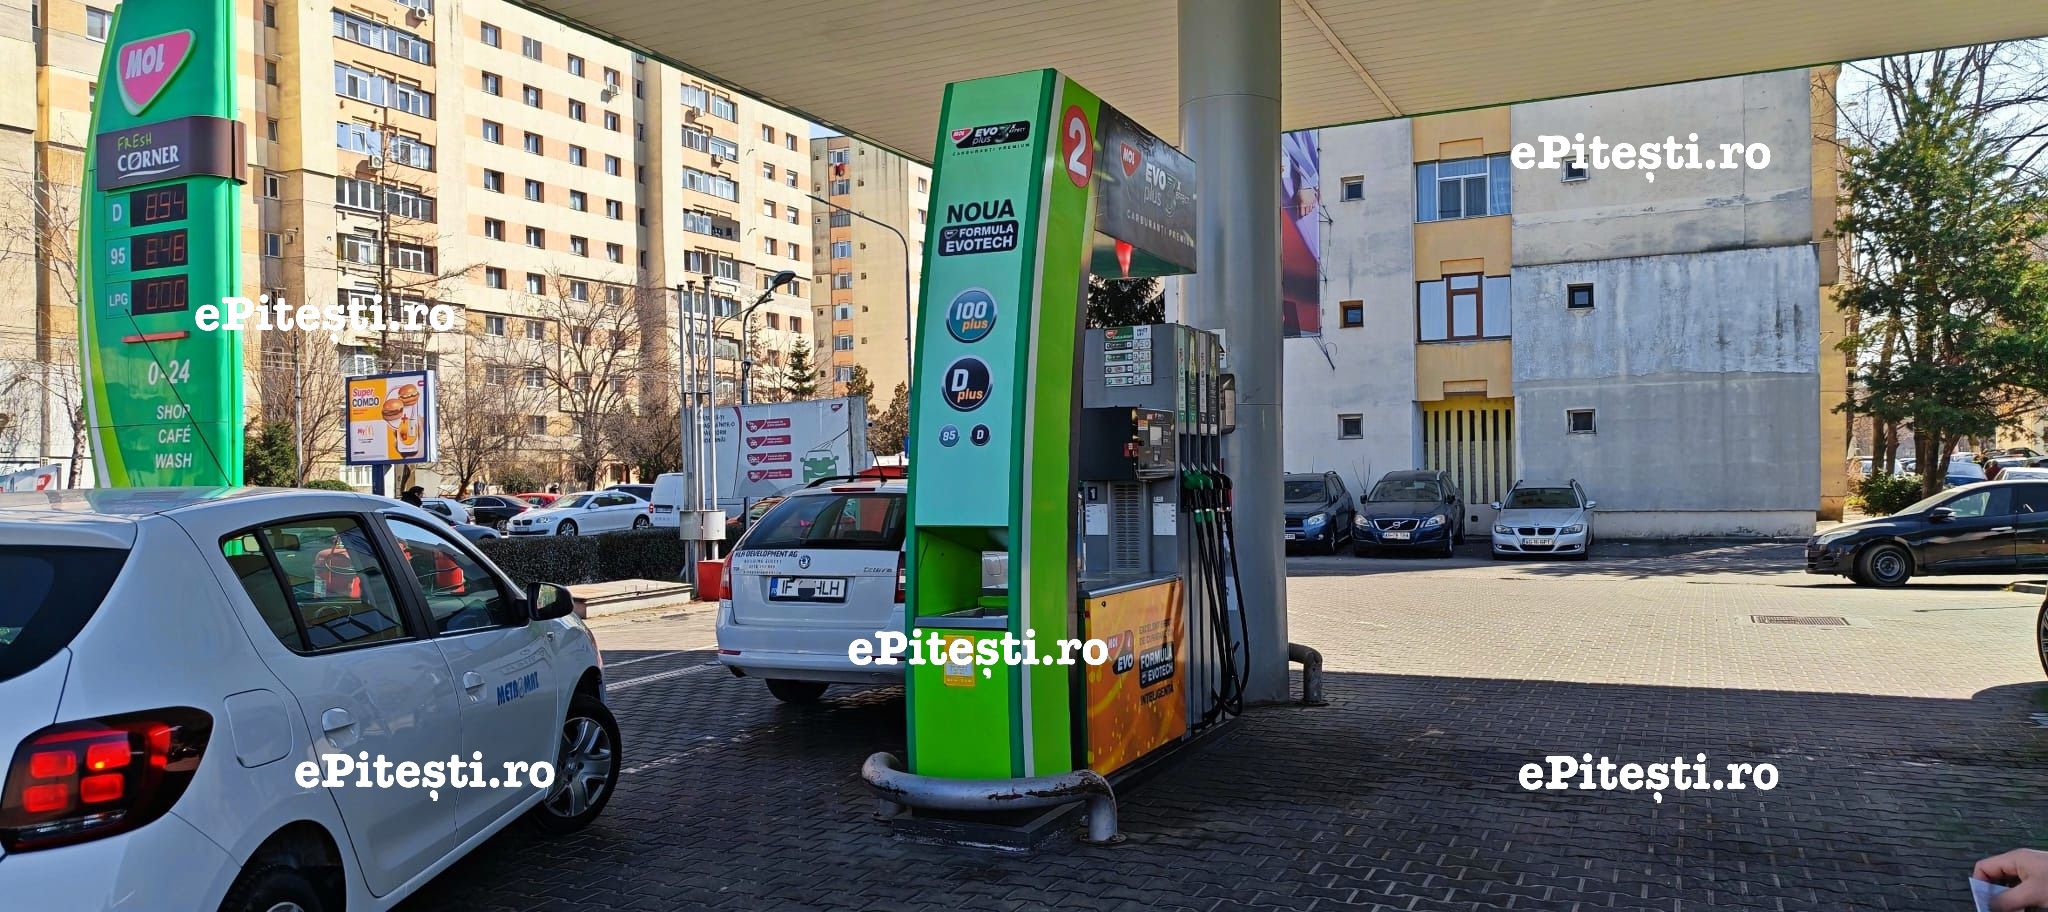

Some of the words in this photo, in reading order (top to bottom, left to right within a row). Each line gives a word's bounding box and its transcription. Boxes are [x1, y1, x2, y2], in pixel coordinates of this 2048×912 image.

[125, 43, 165, 79] MOL
[972, 135, 992, 147] plus
[975, 126, 998, 138] EVO
[117, 132, 152, 151] FRESH
[1068, 117, 1087, 177] 2
[117, 145, 179, 172] CORNER
[1122, 148, 1136, 166] MOL
[1145, 163, 1167, 190] EVO
[1143, 182, 1162, 207] plus
[112, 203, 122, 222] D
[946, 198, 1015, 224] NOUA
[959, 223, 1014, 238] FORMULA
[945, 236, 1013, 253] EVOTECH
[110, 247, 126, 265] 95
[109, 293, 129, 306] LPG
[955, 301, 988, 320] 100
[962, 318, 989, 333] plus
[951, 369, 969, 392] D
[352, 388, 375, 399] Super
[352, 397, 380, 408] COMBO
[956, 387, 984, 403] plus
[156, 404, 191, 420] SHOP
[158, 425, 192, 444] CAFÉ
[977, 429, 985, 440] D
[155, 452, 193, 469] WASH
[788, 550, 799, 558] AG
[1117, 653, 1134, 672] EVO
[1140, 645, 1173, 669] FORMULA
[1148, 662, 1174, 681] EVOTECH
